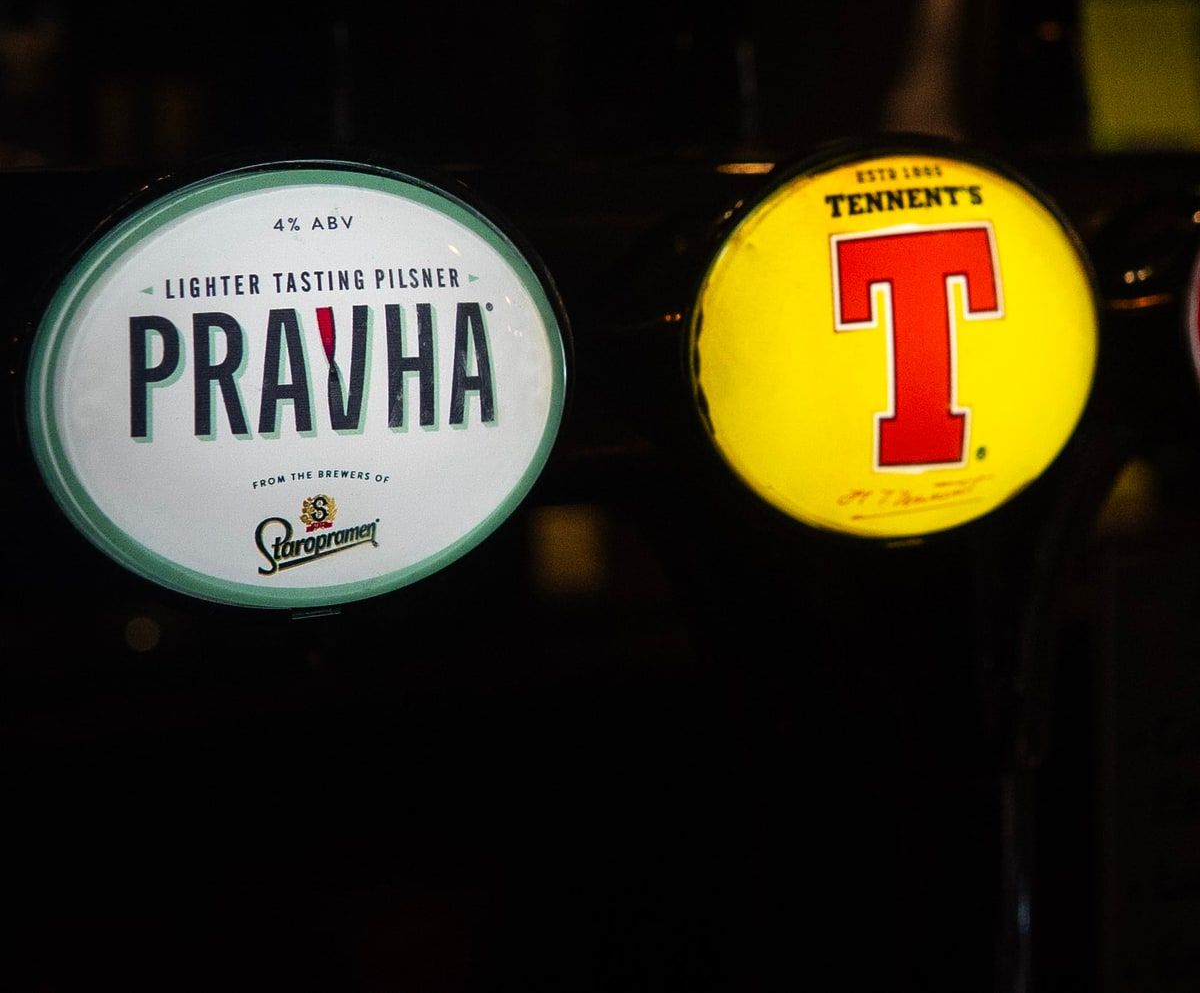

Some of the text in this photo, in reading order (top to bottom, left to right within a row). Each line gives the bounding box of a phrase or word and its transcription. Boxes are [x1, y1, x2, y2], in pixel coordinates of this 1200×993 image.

[825, 185, 983, 218] TENNENT'S
[273, 215, 354, 232] 4% ABV
[165, 267, 460, 300] LIGHTER TASTING PILSNER
[830, 220, 1005, 474] T
[129, 301, 499, 443] PRAVHA
[252, 469, 390, 490] FROM THE BREWERS OF
[254, 516, 380, 576] Staropramen
